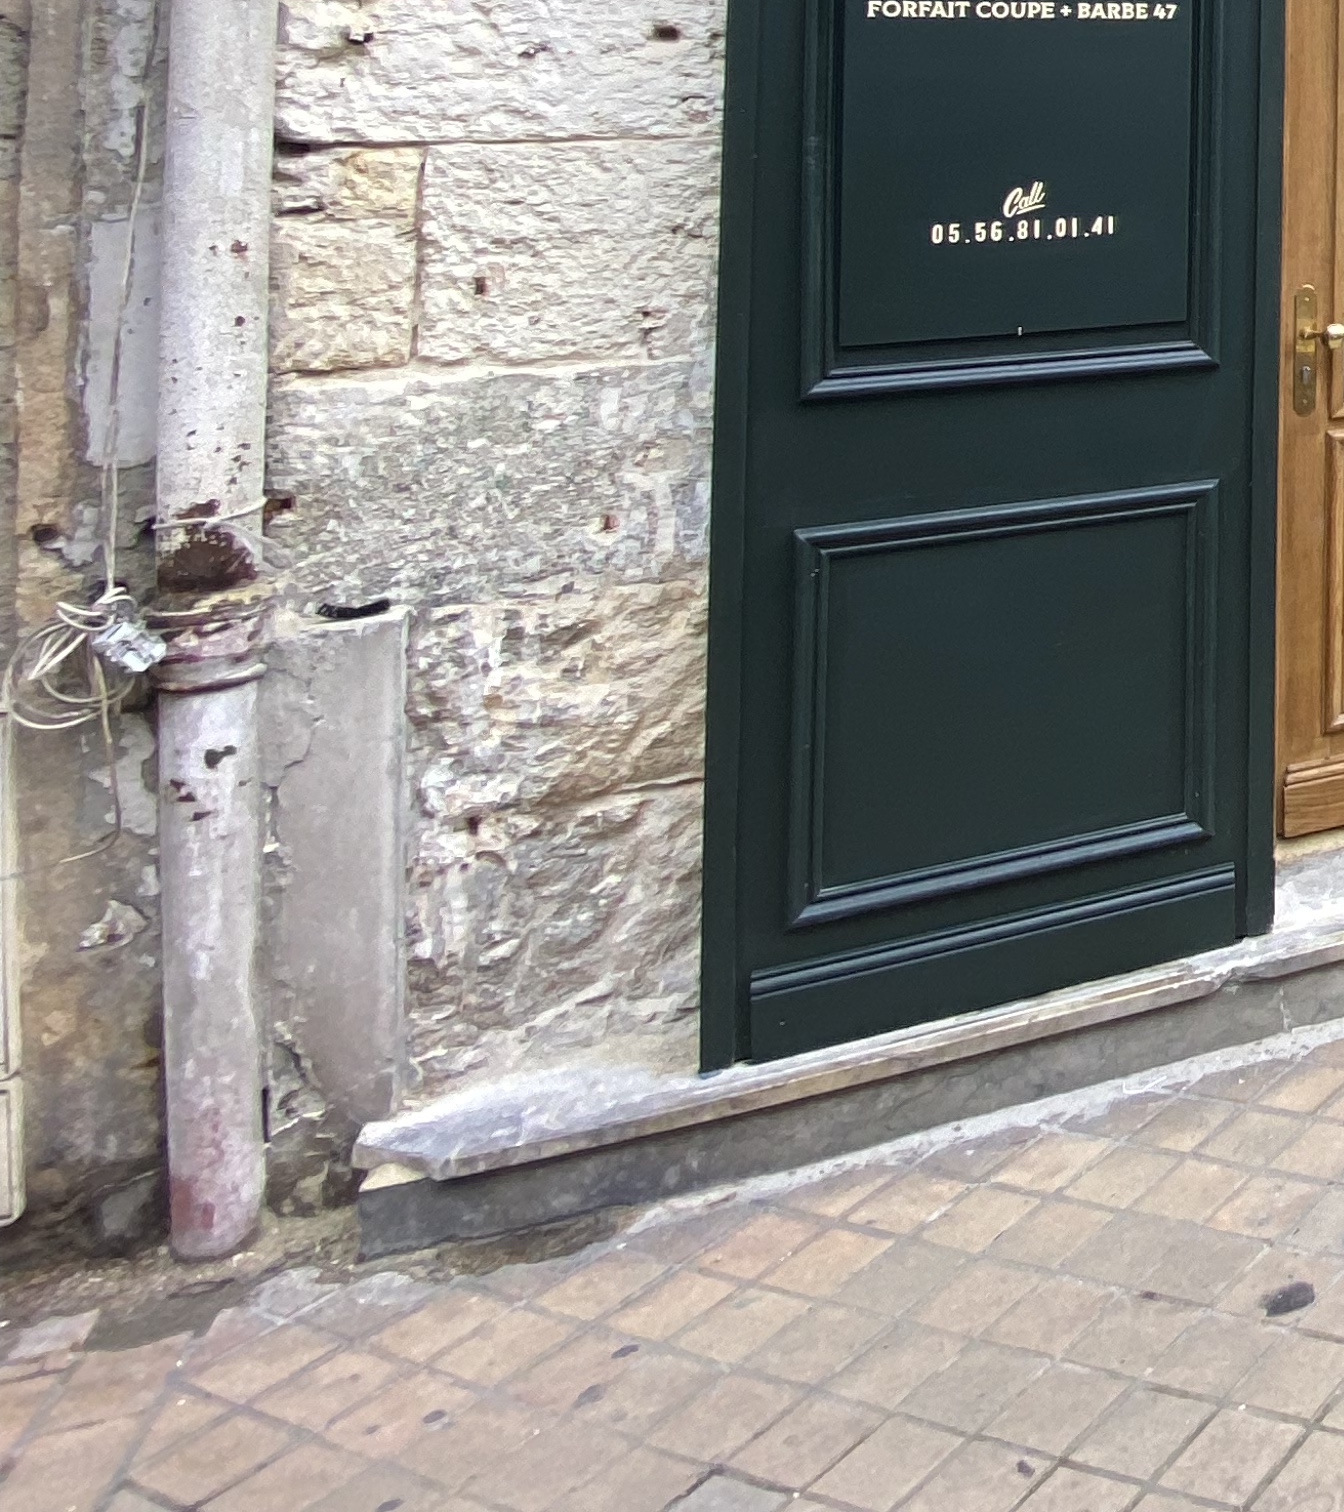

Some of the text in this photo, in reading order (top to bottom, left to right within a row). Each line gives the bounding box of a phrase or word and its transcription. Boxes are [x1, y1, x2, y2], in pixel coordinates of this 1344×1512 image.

[866, 0, 971, 19] FORFAIT
[975, 0, 1056, 19] COUPE
[1077, 2, 1149, 20] BARBE
[1152, 3, 1178, 20] 47
[1003, 180, 1046, 218] Call
[931, 215, 1115, 244] 05.56.81.01.41
